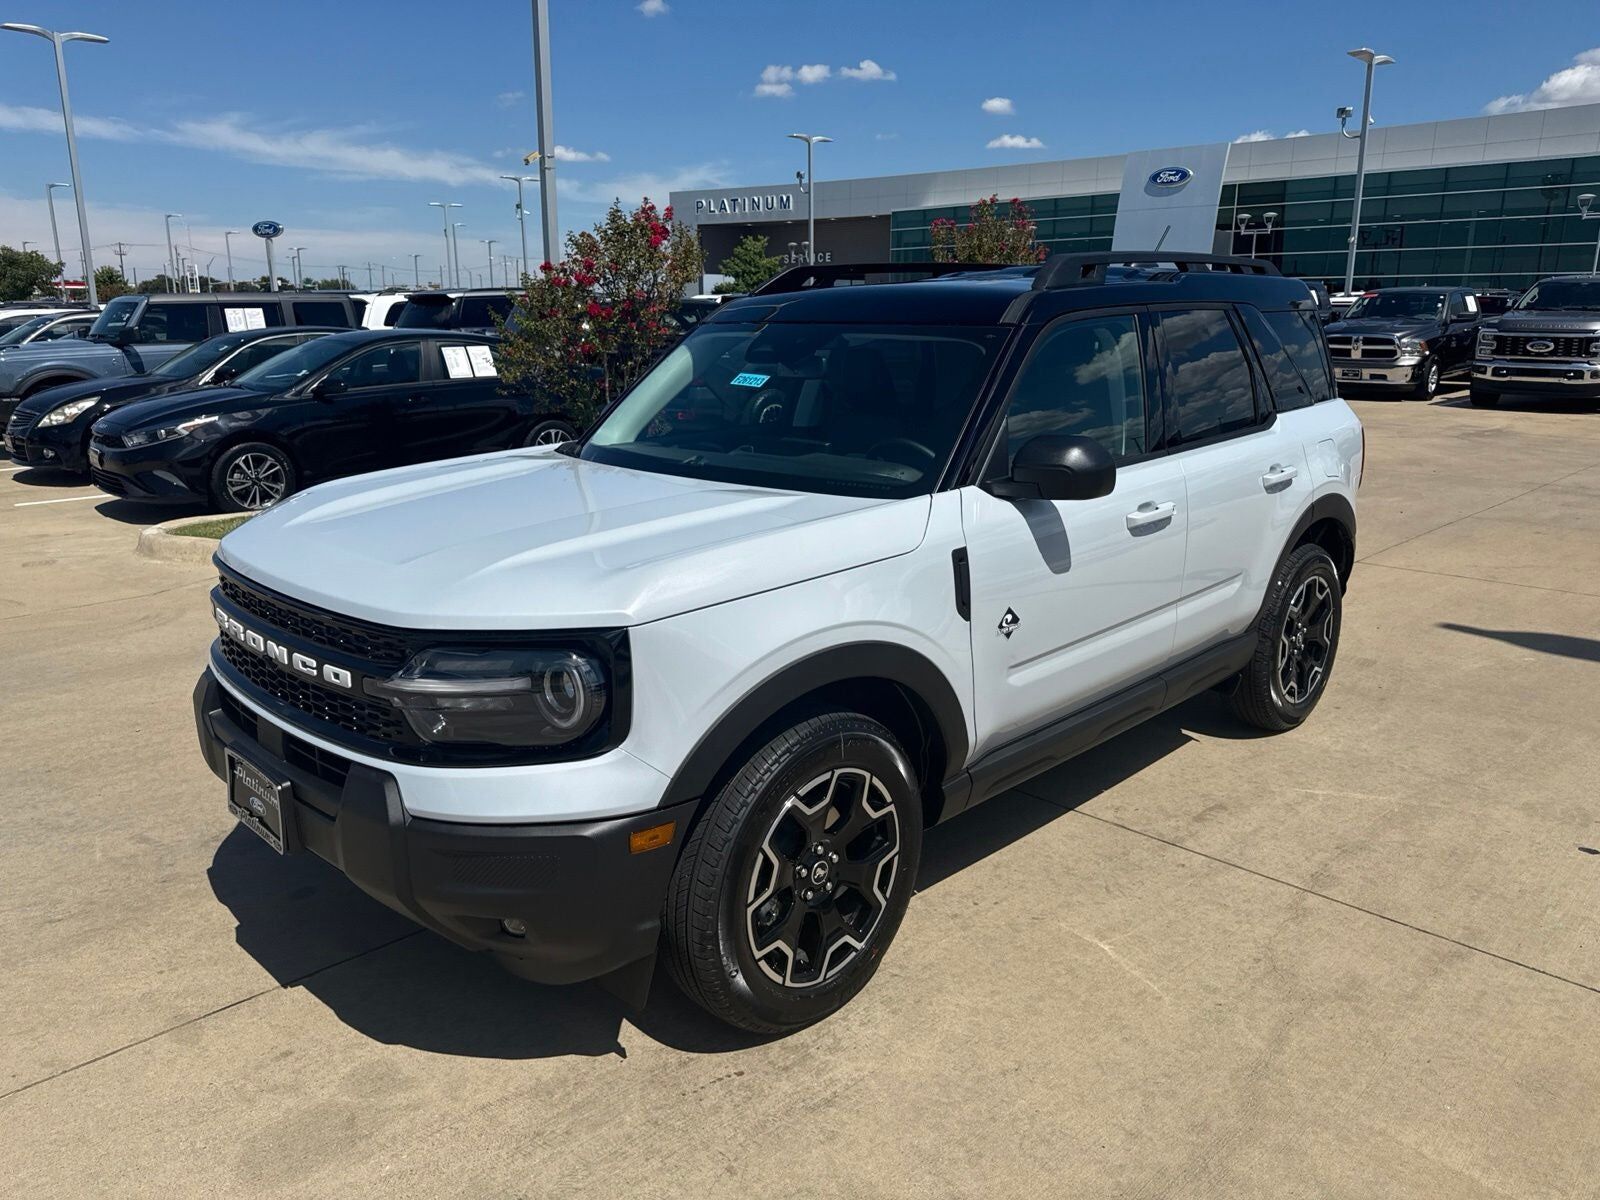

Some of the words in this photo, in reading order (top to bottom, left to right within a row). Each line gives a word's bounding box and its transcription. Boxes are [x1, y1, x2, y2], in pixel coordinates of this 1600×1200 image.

[1156, 171, 1181, 183] Ford
[696, 194, 793, 214] PLATINUM
[215, 607, 352, 689] BRONCO
[234, 766, 279, 810] Platinum
